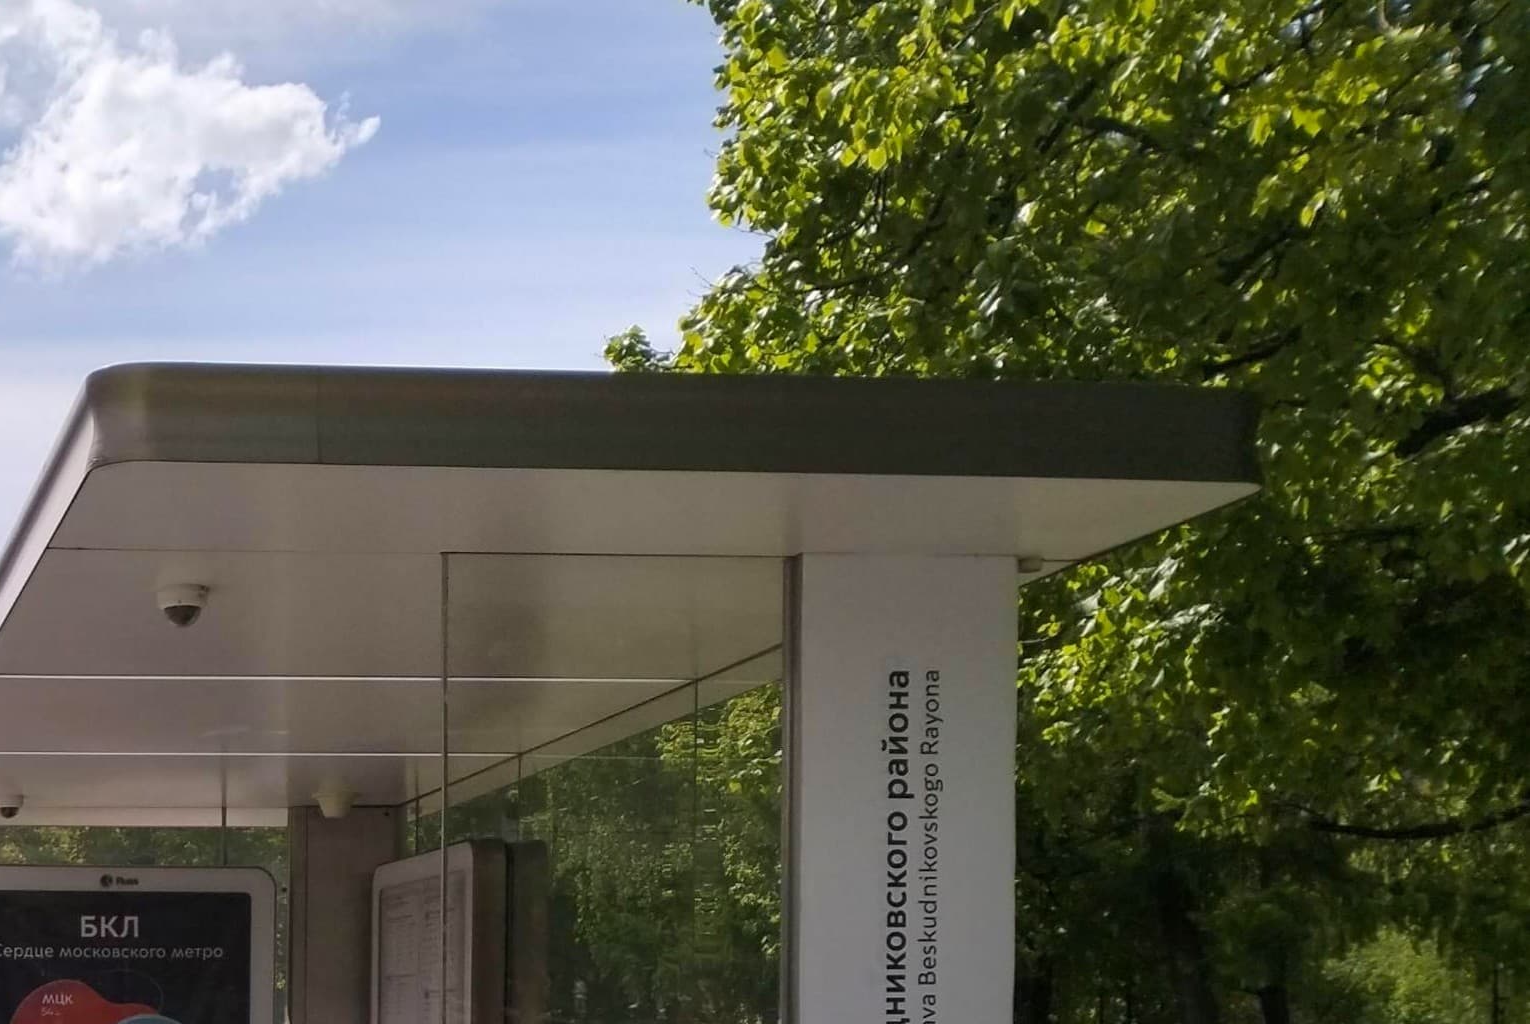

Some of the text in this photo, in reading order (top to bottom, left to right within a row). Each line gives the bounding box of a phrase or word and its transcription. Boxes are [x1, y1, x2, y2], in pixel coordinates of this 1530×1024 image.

[881, 669, 914, 800] района
[920, 669, 944, 755] Rayona
[917, 763, 943, 985] Beskudnikovskogo
[80, 915, 140, 938] БКЛ
[59, 949, 166, 959] московского
[171, 947, 224, 961] метро
[42, 994, 74, 1006] МЦК
